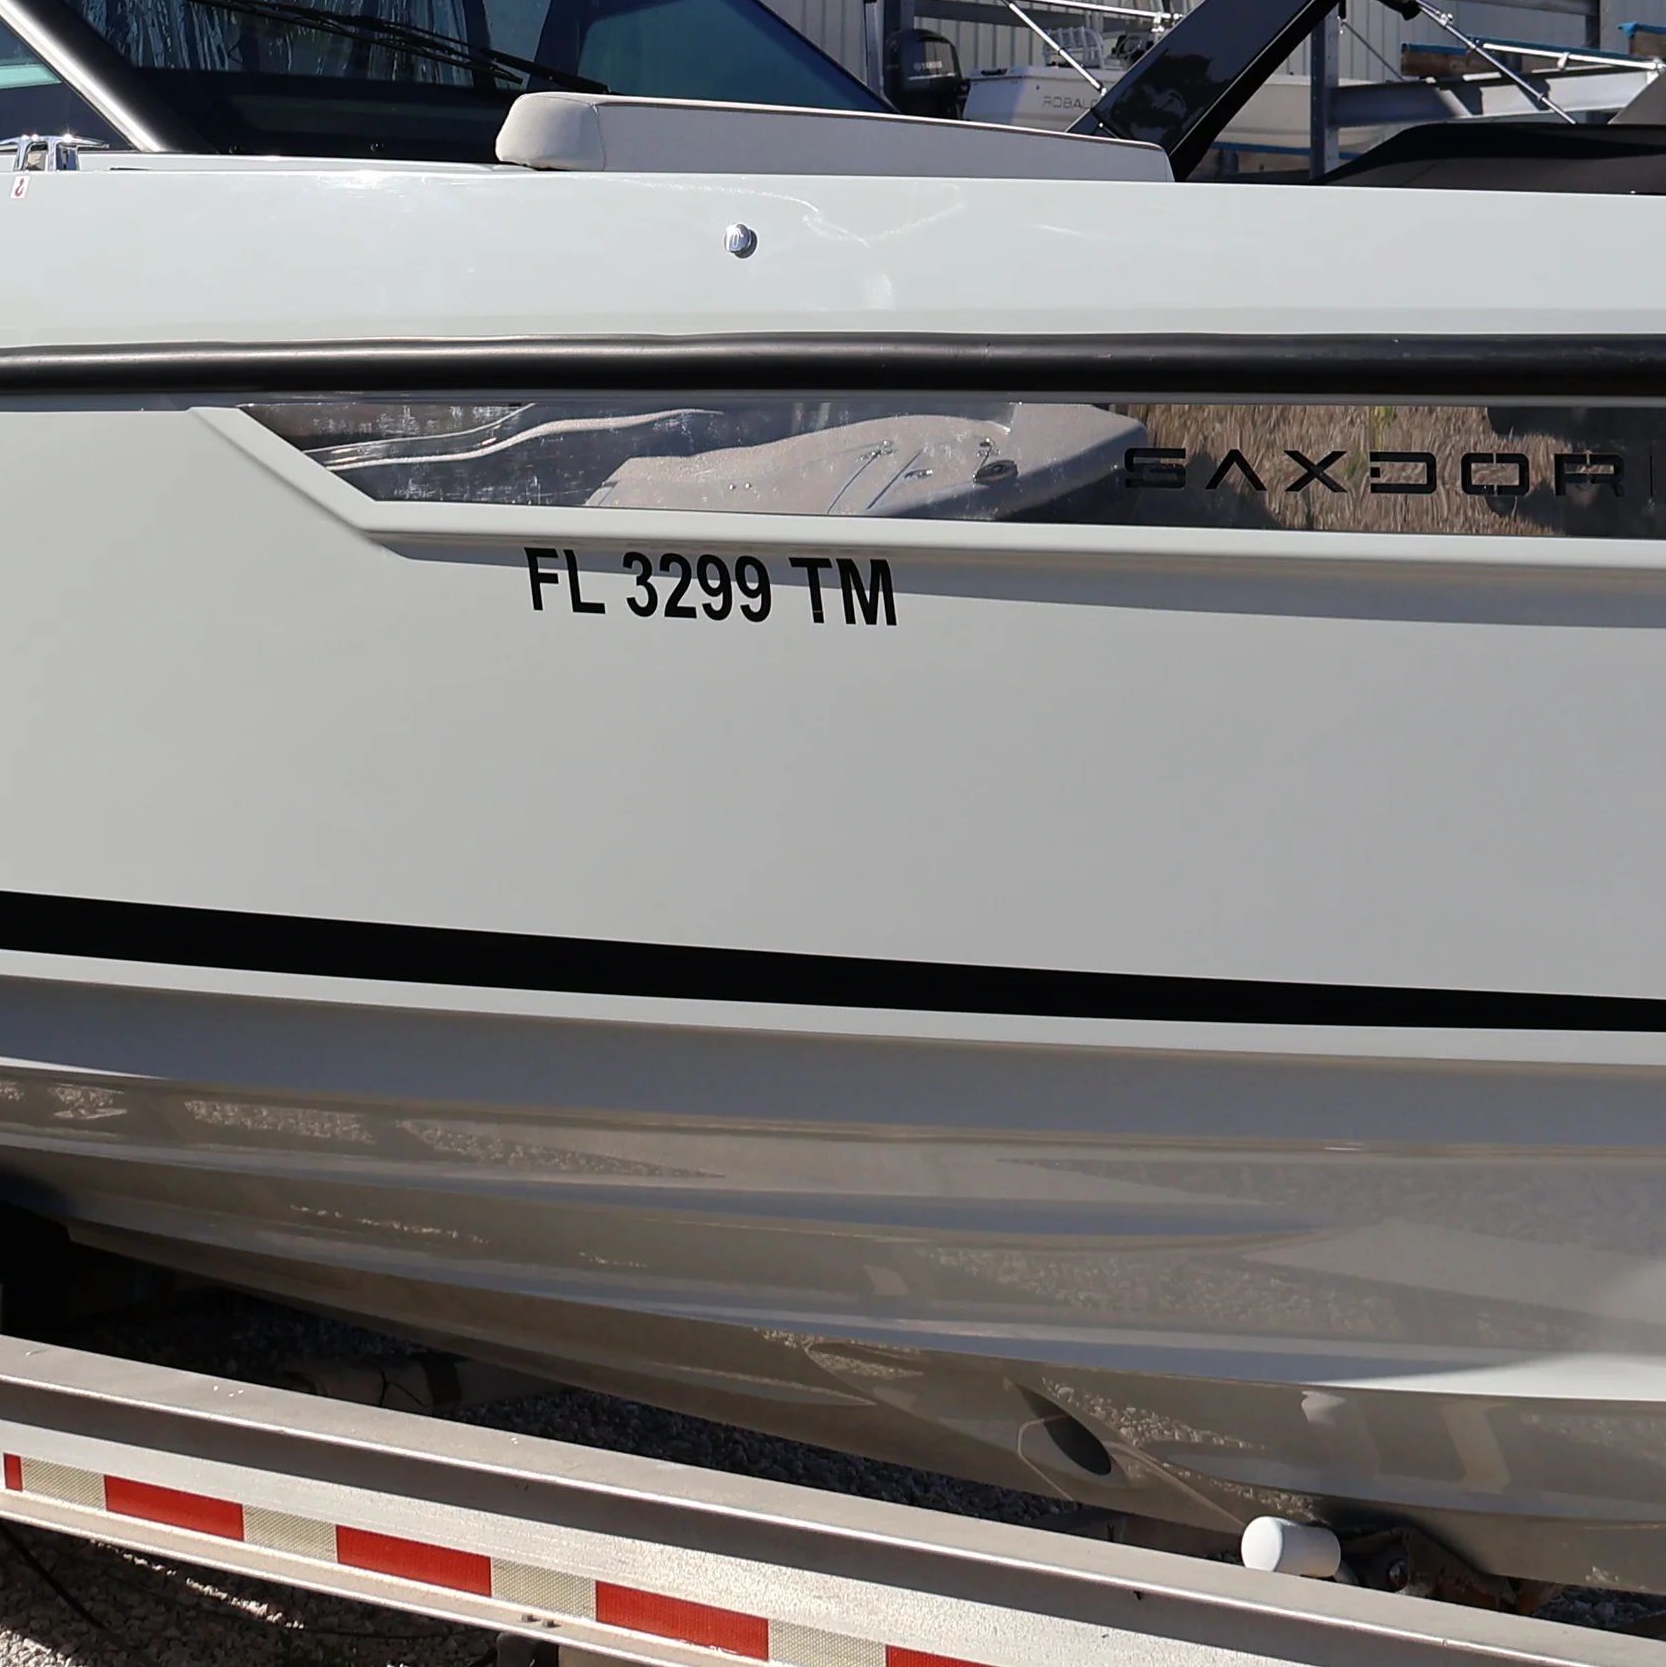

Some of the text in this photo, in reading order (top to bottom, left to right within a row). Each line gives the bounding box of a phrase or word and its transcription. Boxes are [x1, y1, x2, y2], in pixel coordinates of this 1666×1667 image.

[1124, 446, 1625, 498] SAXDOR
[524, 547, 898, 626] FL 3299 TM
